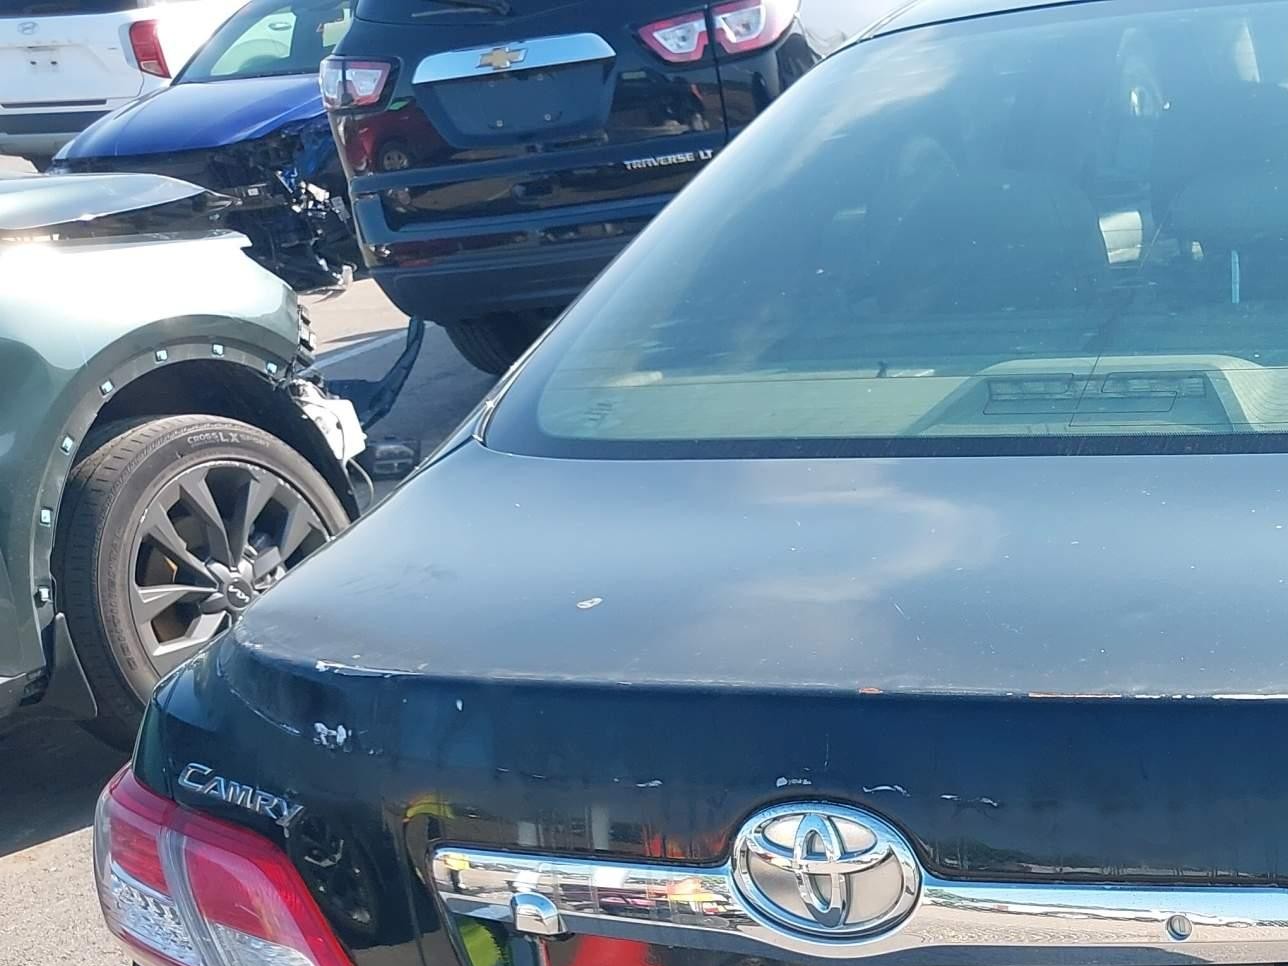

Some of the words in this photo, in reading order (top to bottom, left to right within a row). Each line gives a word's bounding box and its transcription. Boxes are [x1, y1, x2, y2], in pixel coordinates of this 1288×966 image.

[623, 152, 695, 170] TRAVERSE
[699, 149, 713, 160] LT
[178, 762, 304, 830] CAMRY
